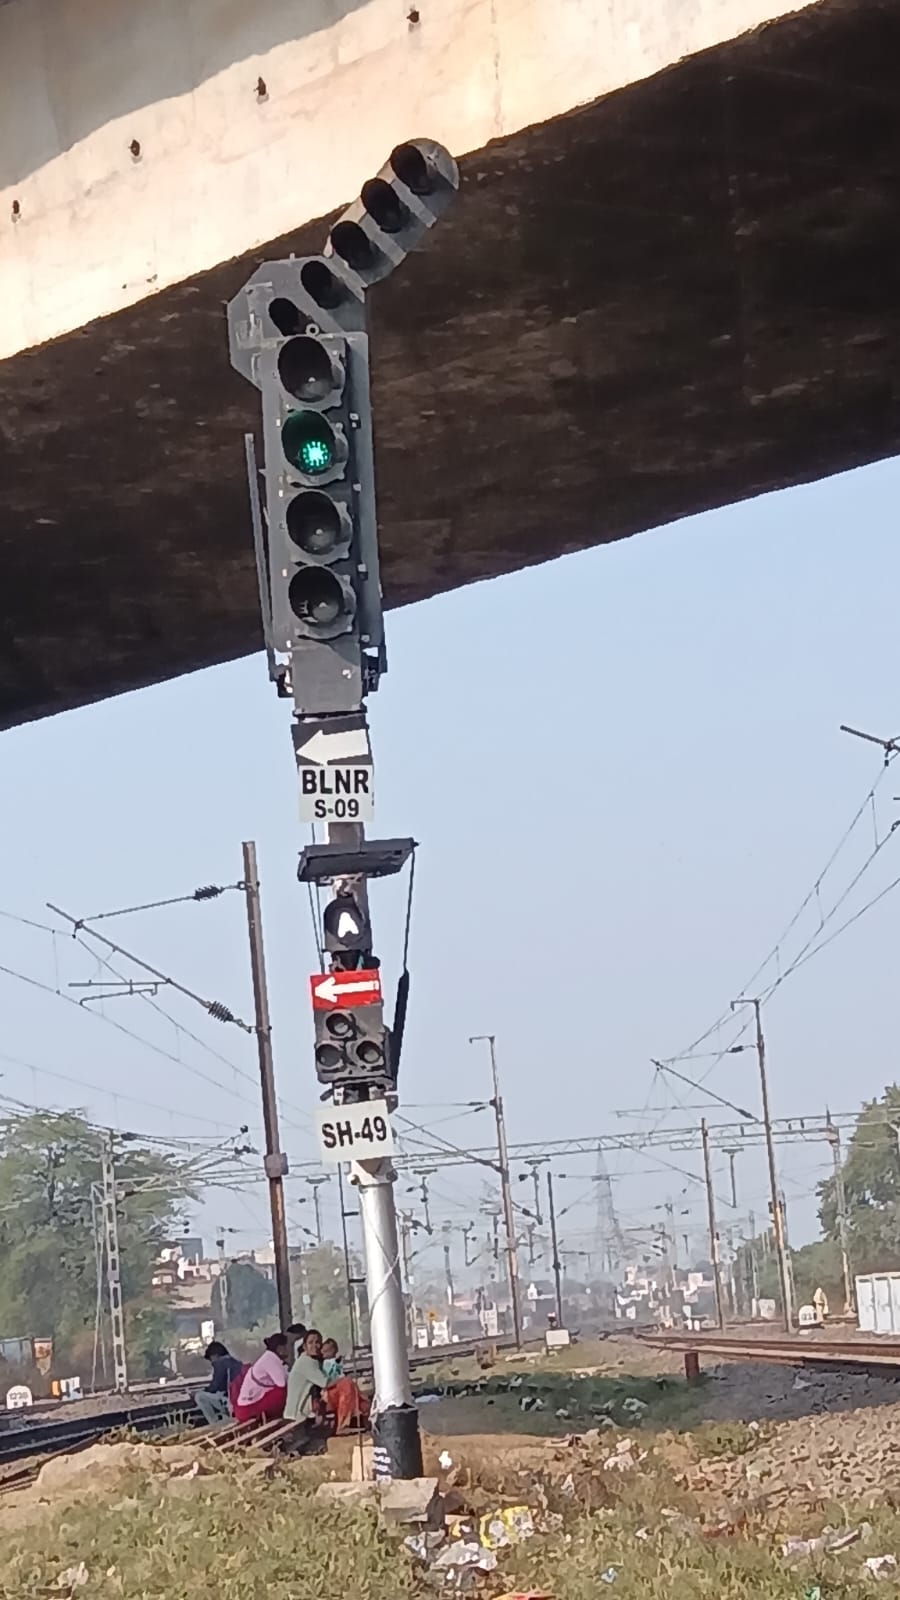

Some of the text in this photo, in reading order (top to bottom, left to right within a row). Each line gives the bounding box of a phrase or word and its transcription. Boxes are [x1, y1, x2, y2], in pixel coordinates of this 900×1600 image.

[302, 769, 369, 794] BLNR
[314, 798, 359, 818] S-09
[337, 911, 359, 938] A
[321, 1115, 387, 1149] SH-49
